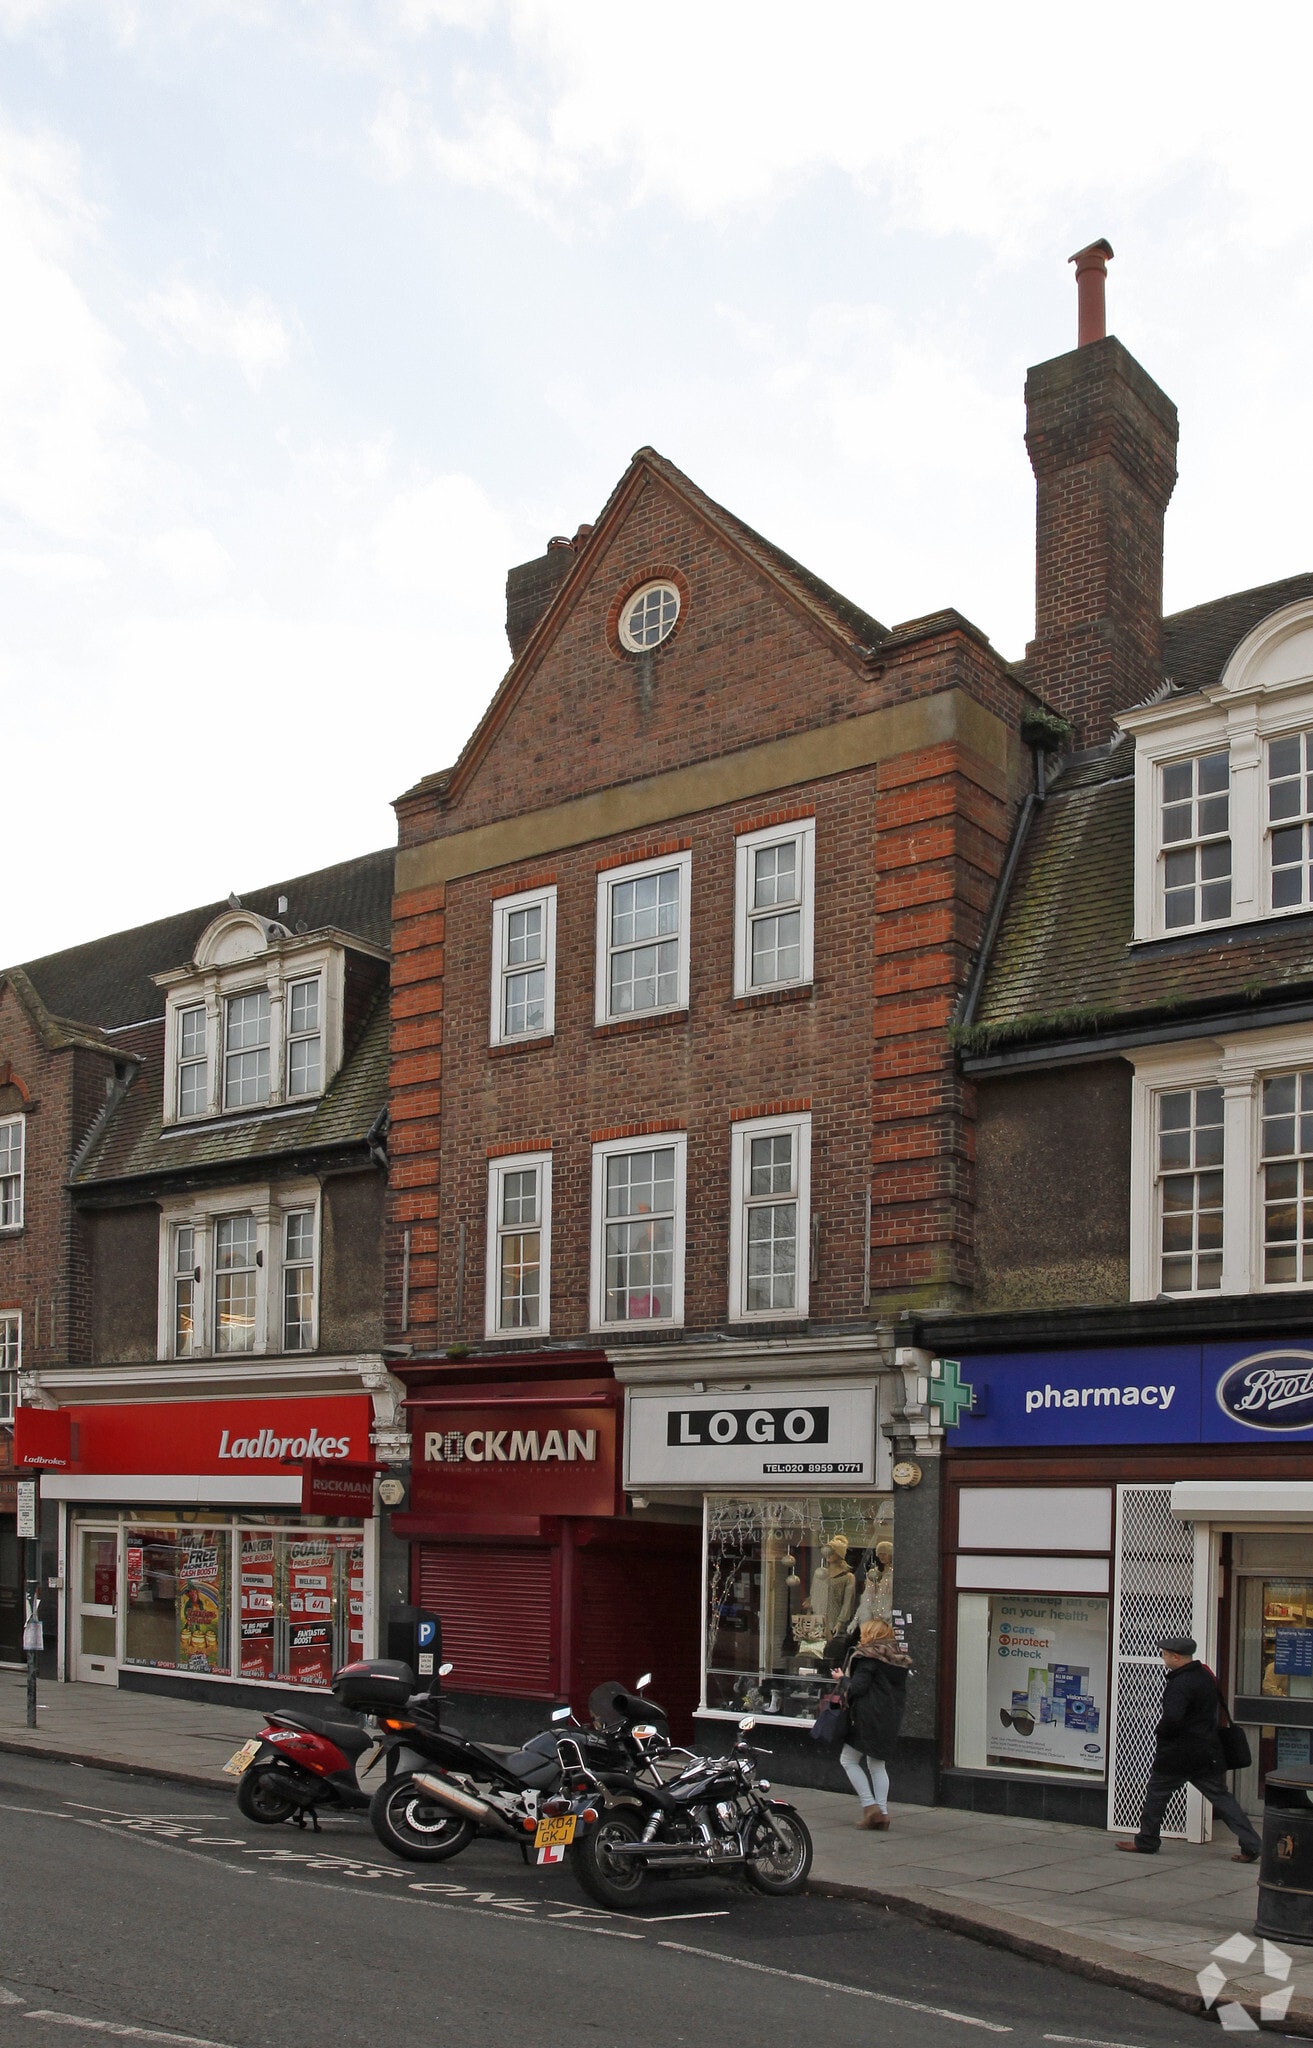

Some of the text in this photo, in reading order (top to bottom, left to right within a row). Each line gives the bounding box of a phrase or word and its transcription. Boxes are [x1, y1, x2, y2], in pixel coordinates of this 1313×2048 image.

[1025, 1384, 1176, 1413] pharmacy
[680, 1409, 815, 1444] LOGO
[218, 1428, 350, 1459] Ladbrokes
[424, 1429, 597, 1463] ROCKMAN
[23, 1455, 67, 1466] Ladbrokes
[766, 1463, 861, 1473] TEL:020 8959 0771
[313, 1478, 372, 1494] ROCKMAN
[241, 1540, 273, 1553] ANKER
[190, 1550, 216, 1563] FREE
[241, 1555, 253, 1563] RICE
[293, 1557, 330, 1567] PRICE BOOST
[181, 1569, 197, 1577] CASH
[312, 1600, 324, 1608] 6/1
[1001, 1607, 1089, 1621] on your health
[297, 1628, 327, 1637] FANTASTIC
[420, 1624, 431, 1642] P
[1012, 1626, 1036, 1634] care
[293, 1636, 312, 1645] BOOST
[1011, 1637, 1049, 1648] protect
[1010, 1648, 1042, 1659] check
[298, 1662, 321, 1674] Ladbrokes
[540, 1816, 573, 1831] EK04
[541, 1830, 568, 1842] GKJ
[543, 1846, 558, 1862] L
[101, 1818, 247, 1845] SOLO
[408, 1883, 612, 1918] ONLY
